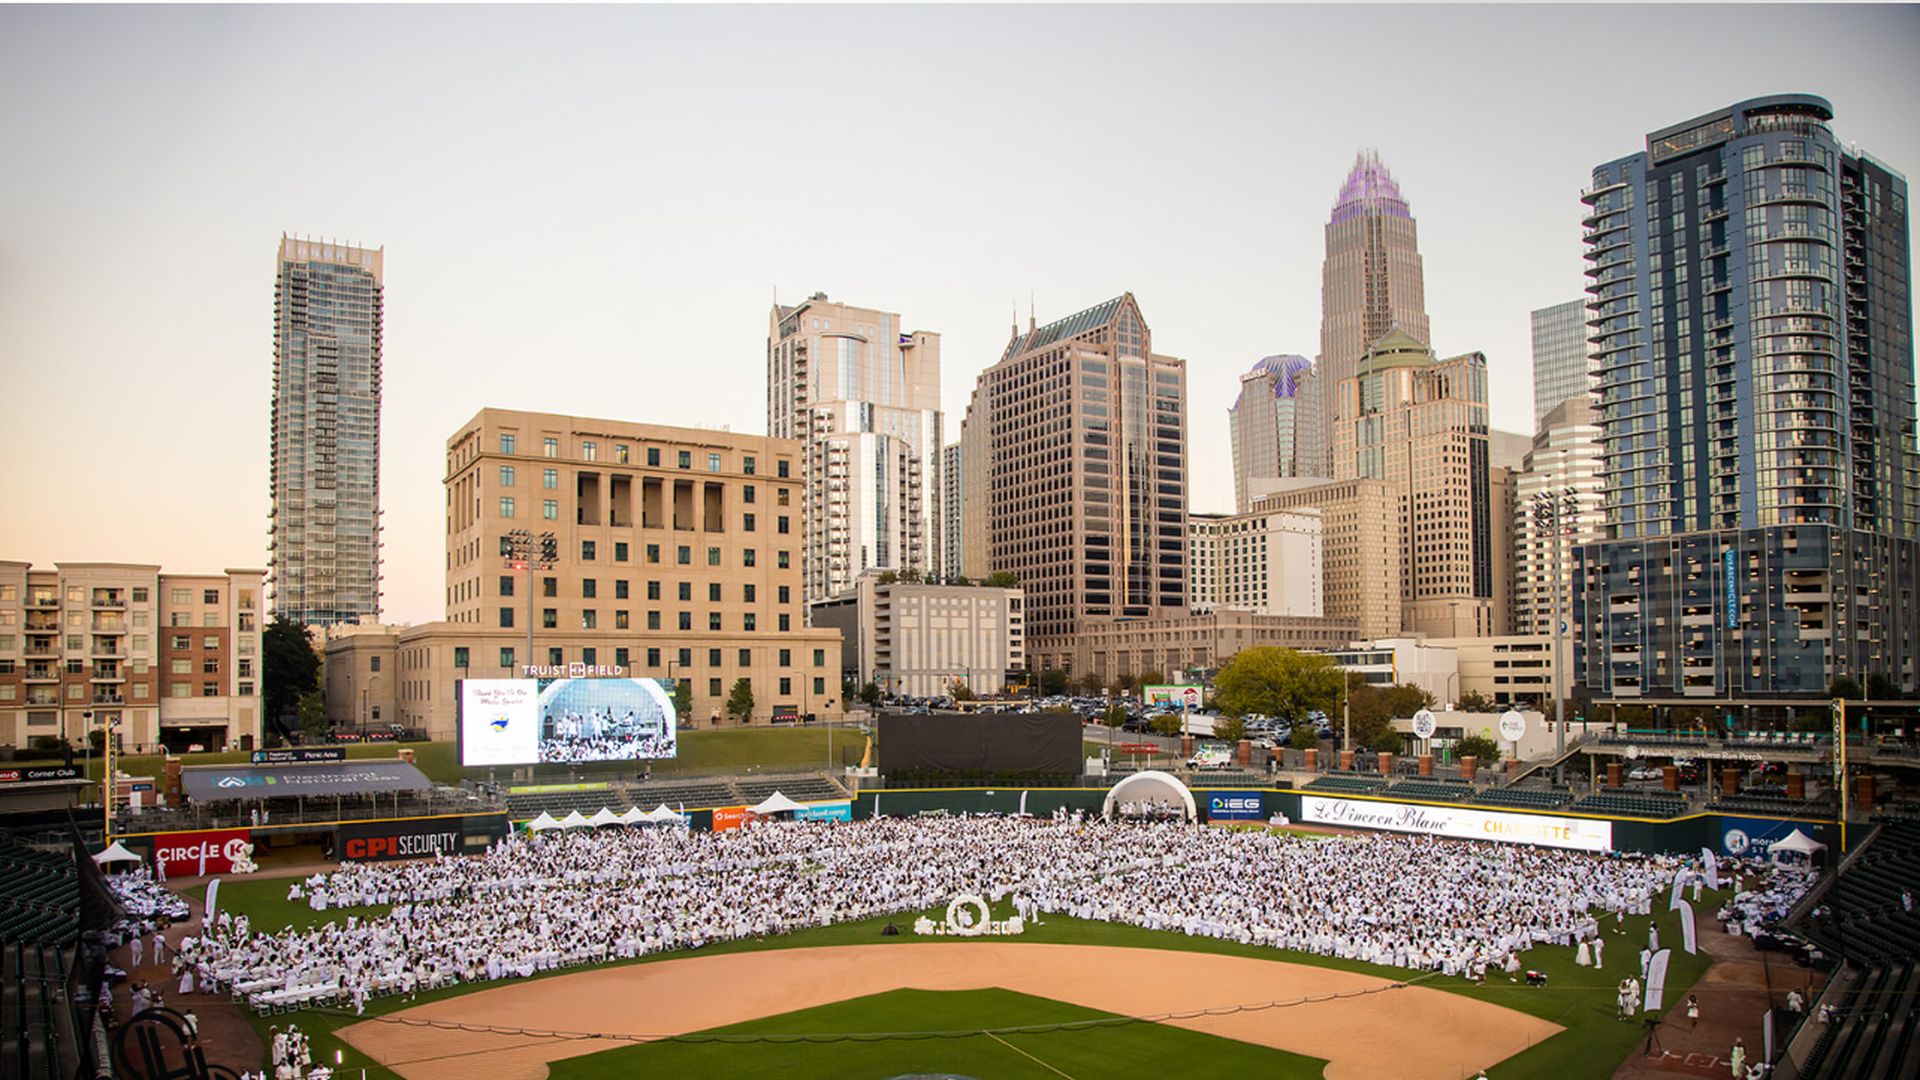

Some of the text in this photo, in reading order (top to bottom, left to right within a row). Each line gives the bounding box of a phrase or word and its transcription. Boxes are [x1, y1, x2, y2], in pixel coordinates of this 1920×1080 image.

[521, 665, 622, 676] TRUIST FIELD
[27, 770, 55, 779] Corner
[56, 768, 75, 777] Club
[1484, 819, 1570, 840] CHAROTTE
[346, 832, 457, 858] CPI SECURITY
